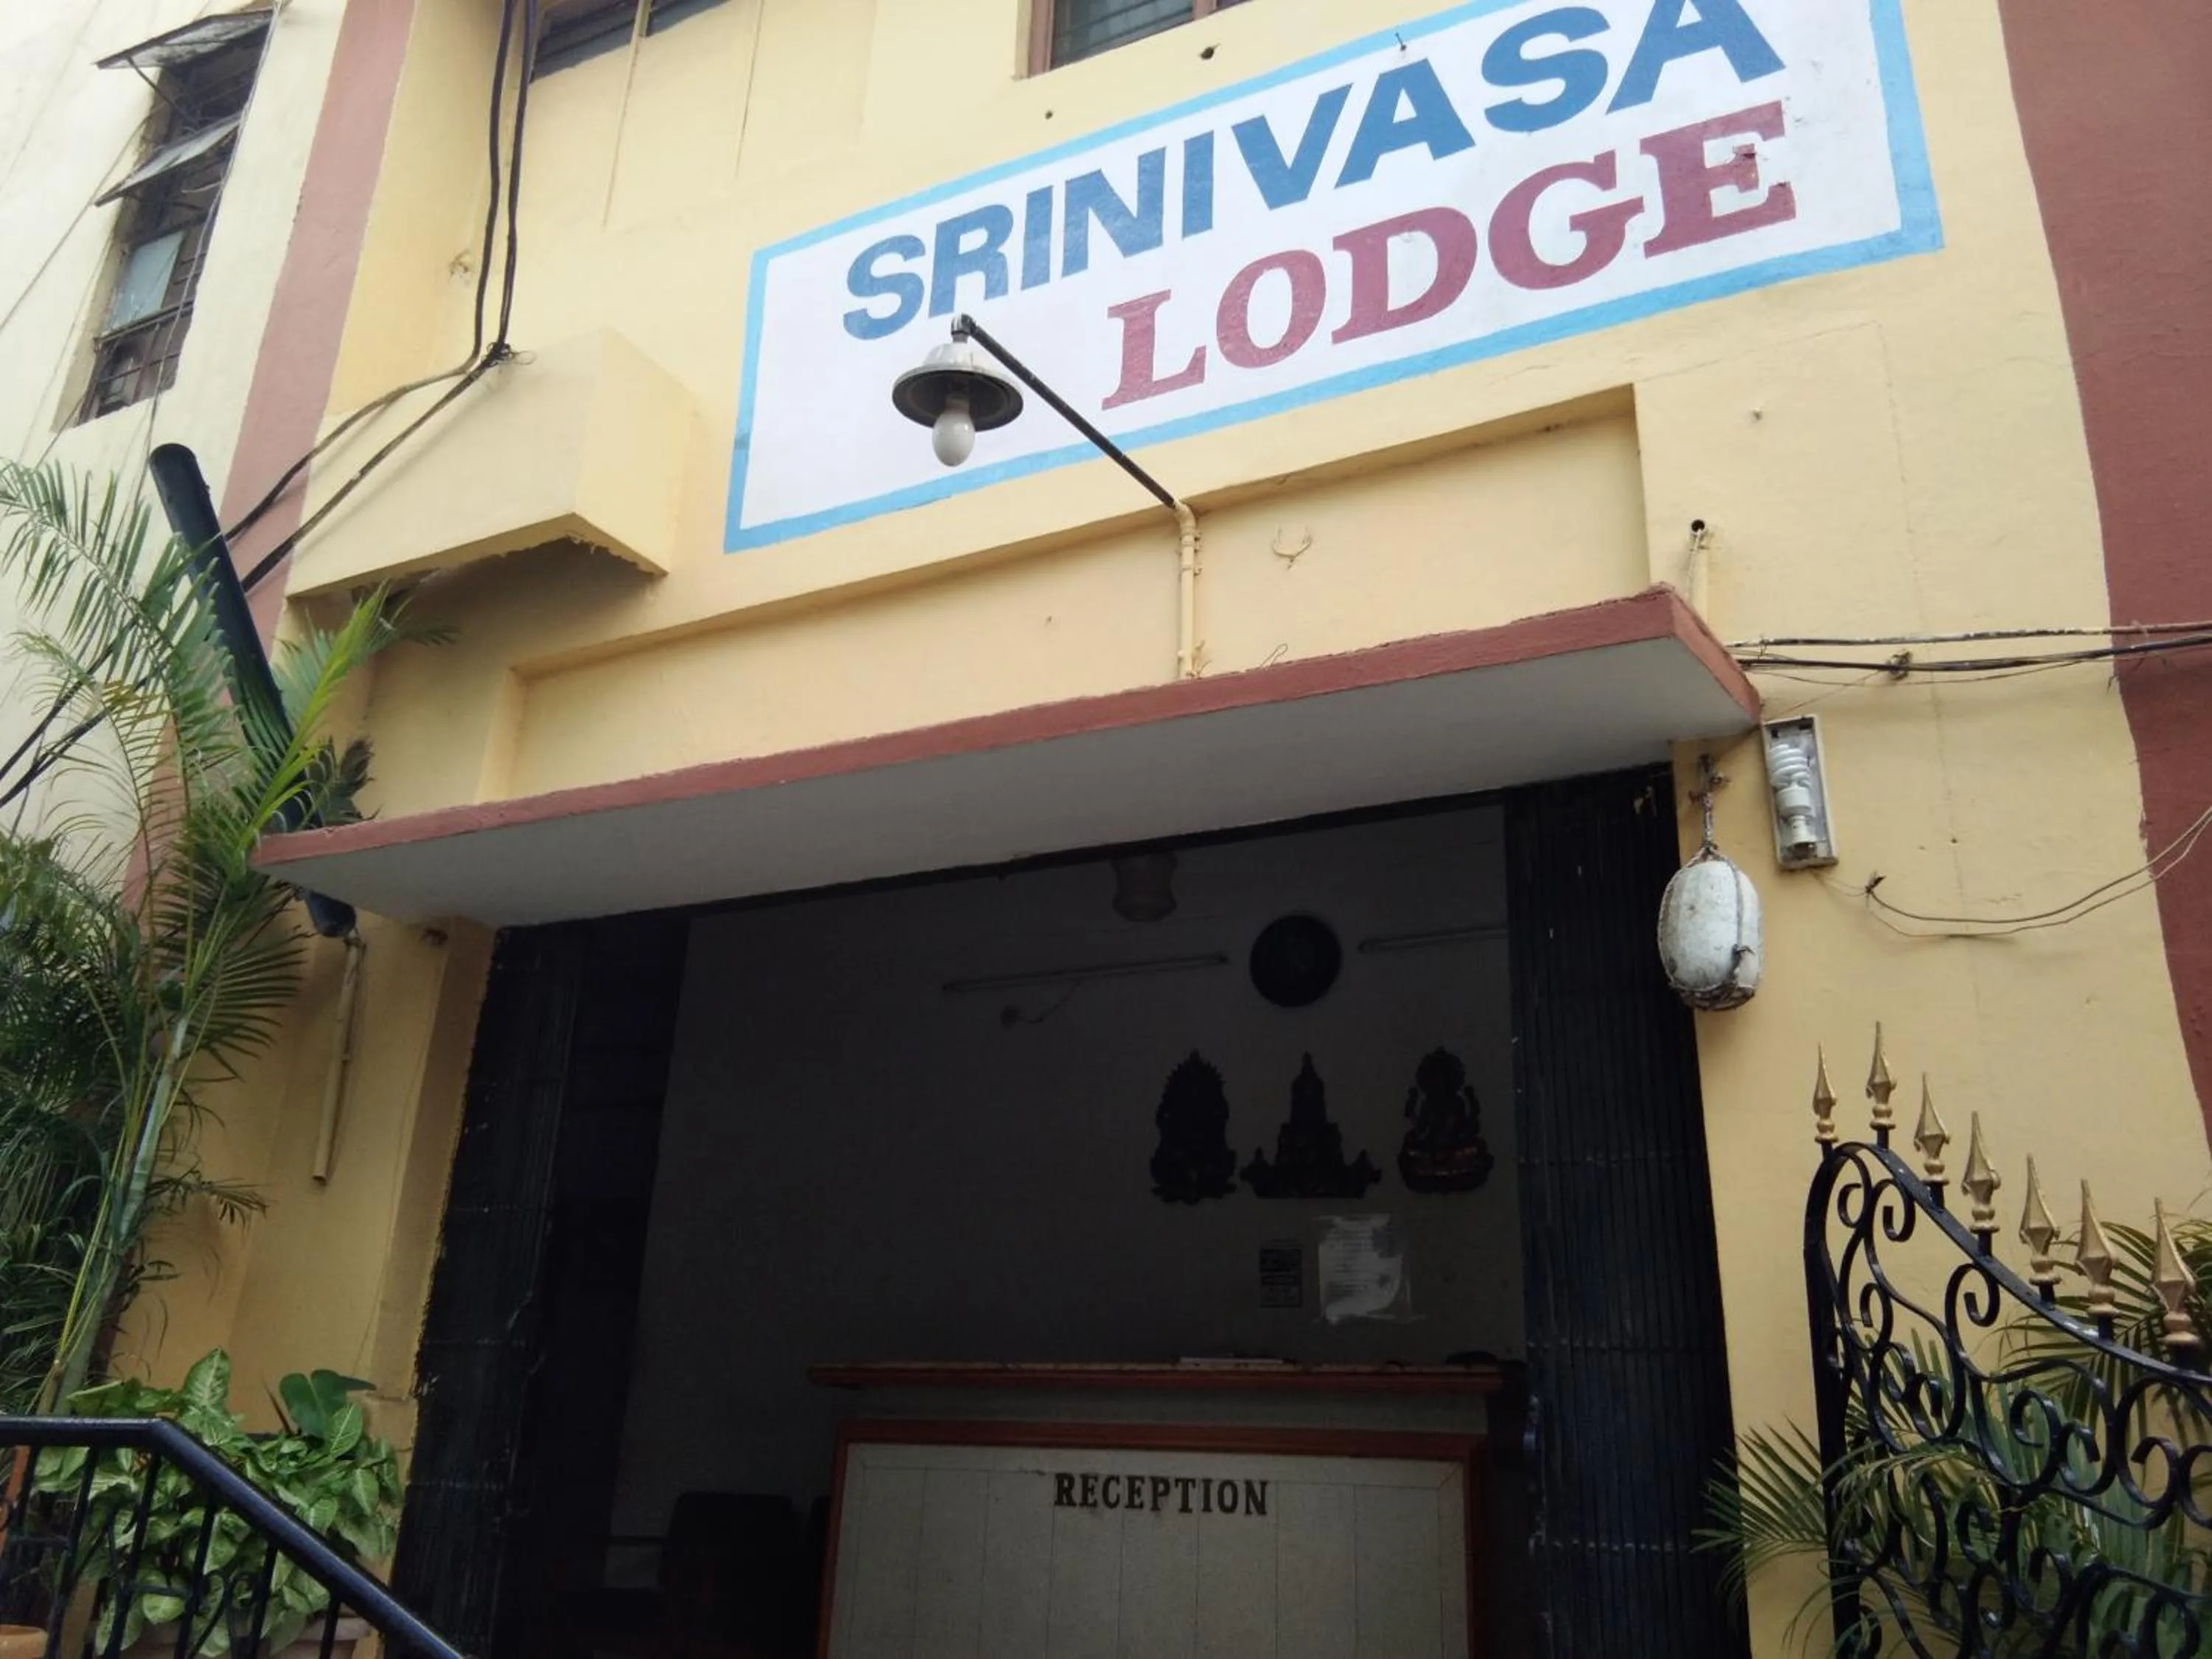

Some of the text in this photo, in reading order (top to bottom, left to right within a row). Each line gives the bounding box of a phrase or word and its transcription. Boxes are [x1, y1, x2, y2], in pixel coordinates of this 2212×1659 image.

[844, 0, 1785, 340] SRINIVASA
[1102, 100, 1795, 409] LODGE
[1055, 1473, 1268, 1515] RECEPTION
